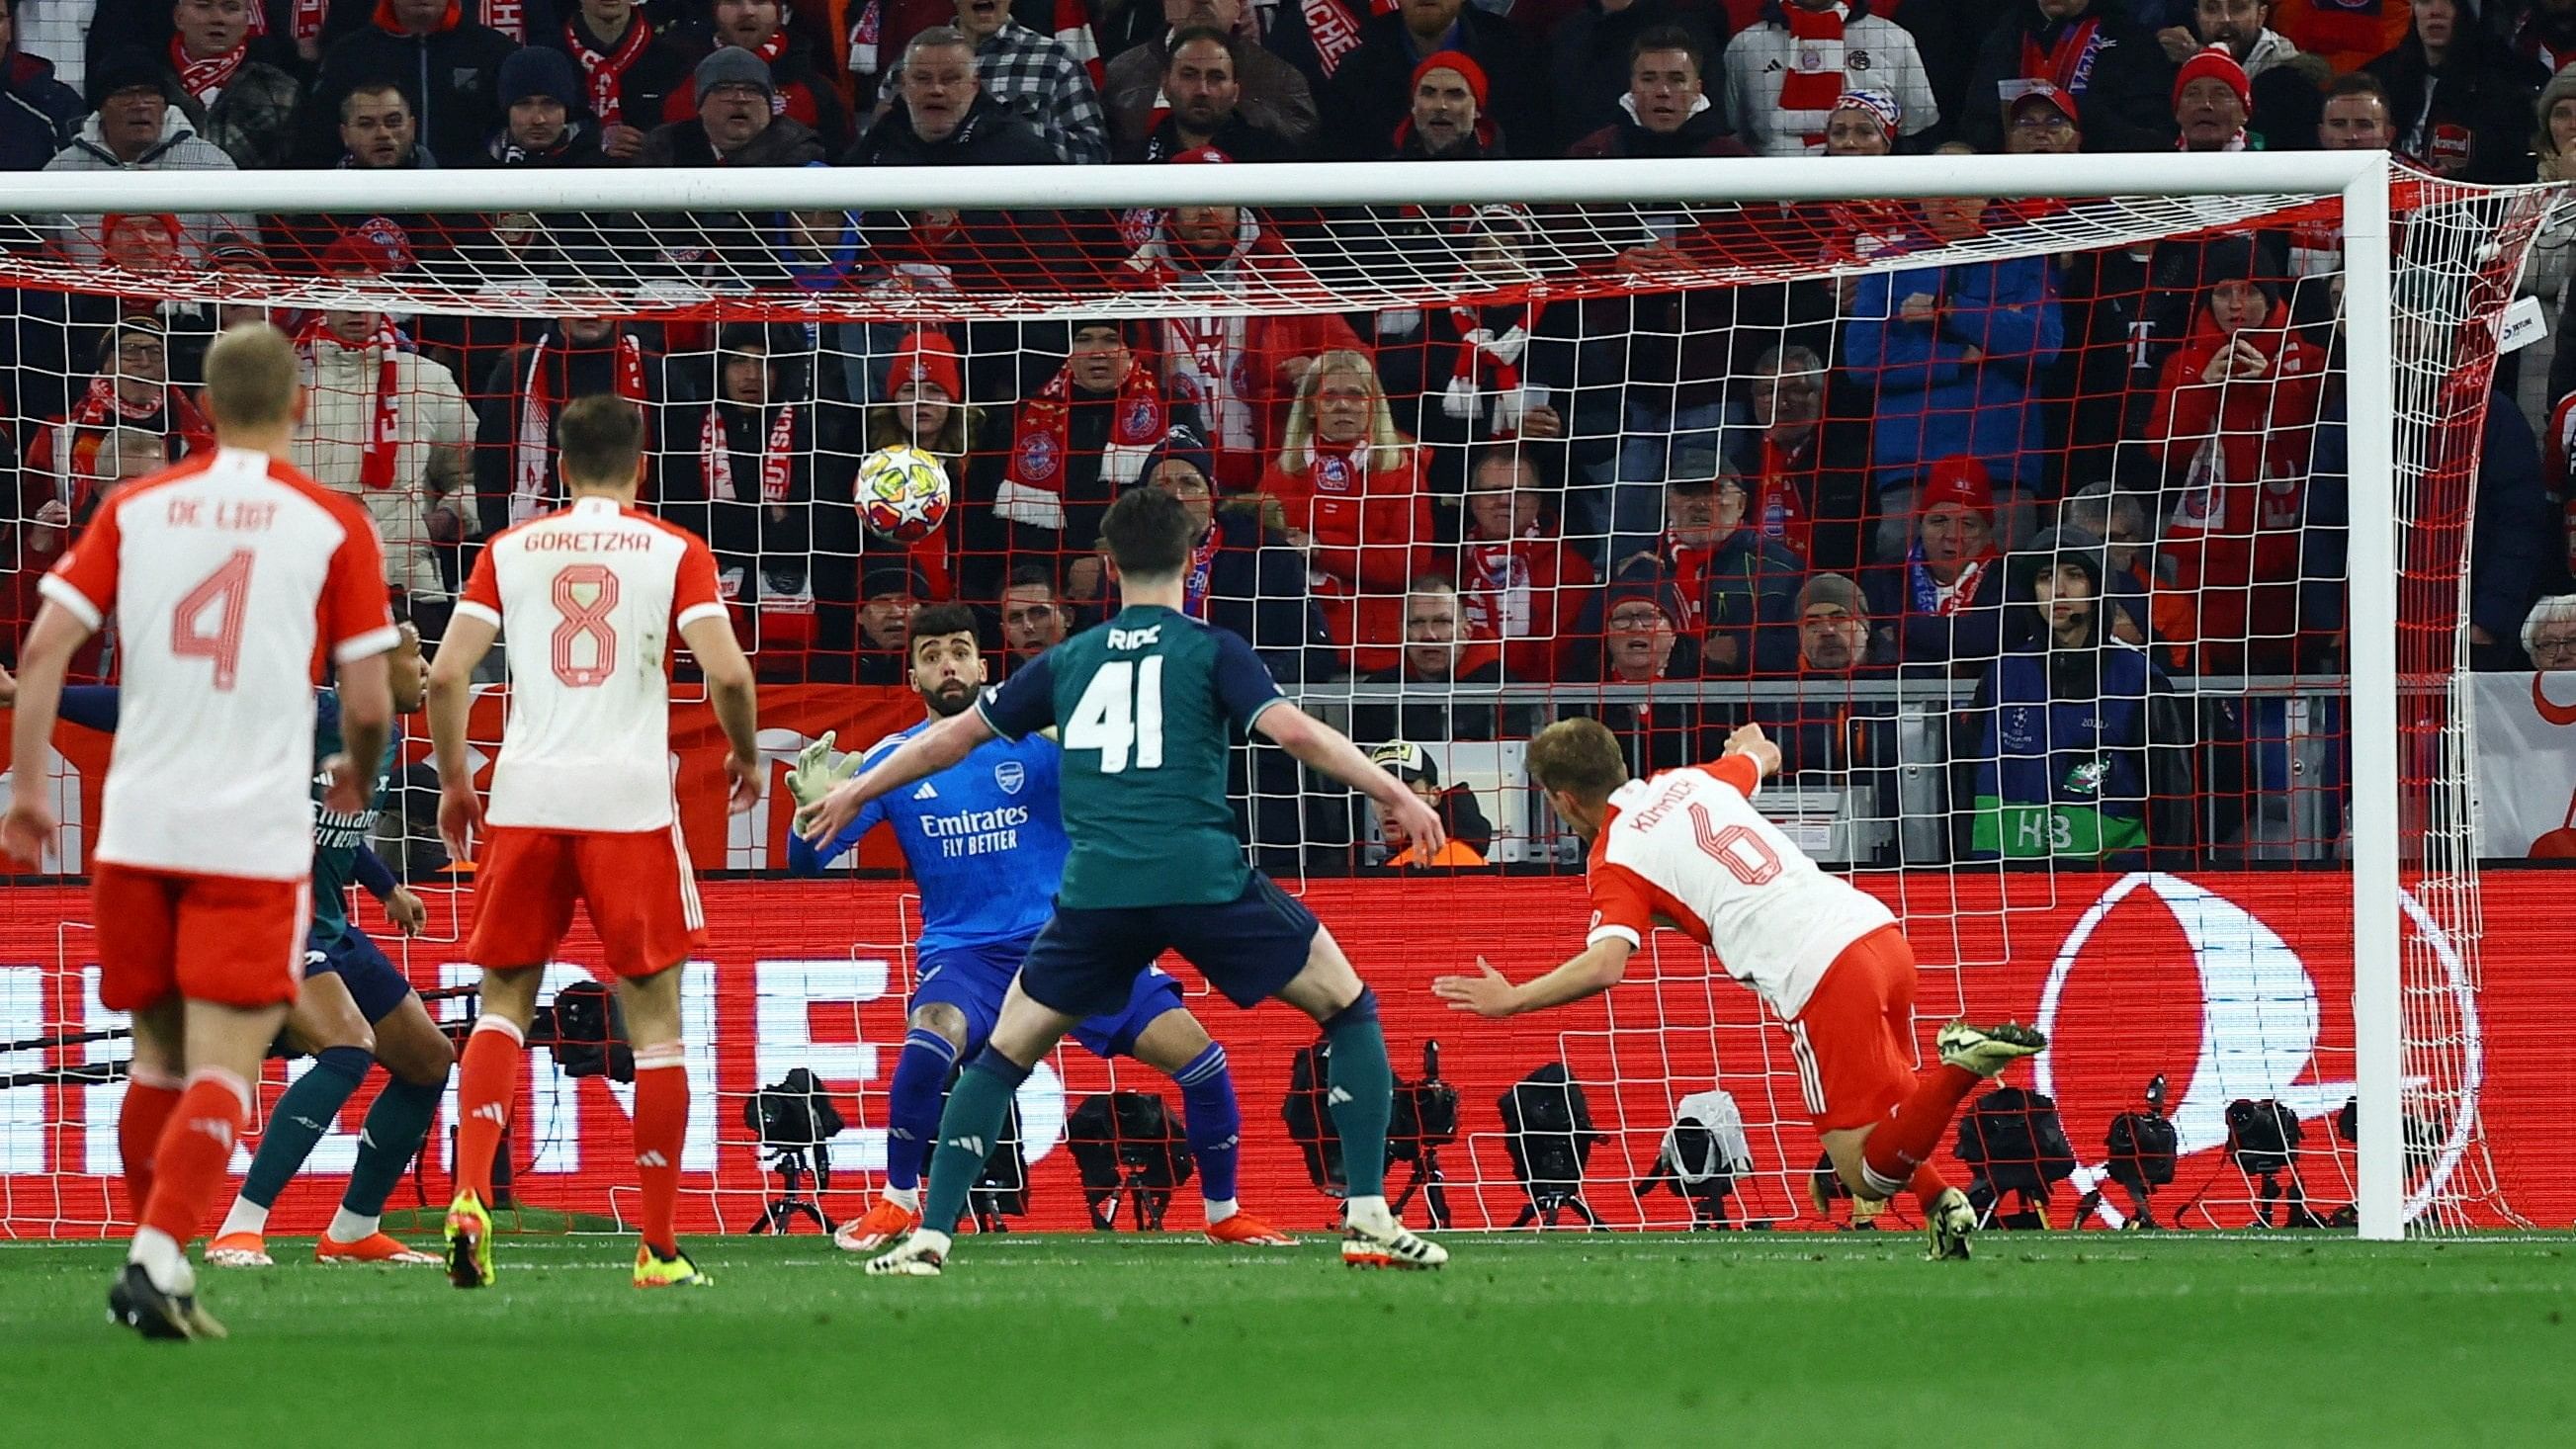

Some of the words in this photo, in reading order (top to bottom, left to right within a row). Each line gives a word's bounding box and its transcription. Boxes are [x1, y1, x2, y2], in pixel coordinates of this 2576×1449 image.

[1301, 0, 1357, 66] CHE
[524, 531, 651, 554] GORETZKA
[171, 547, 254, 691] 4
[552, 563, 619, 688] 8
[1063, 653, 1163, 774] 41
[918, 805, 1029, 838] Emirates
[1628, 777, 1700, 834] KIMMICH
[942, 836, 965, 859] FLY
[968, 828, 1018, 857] BETTER
[1687, 802, 1783, 886] 6
